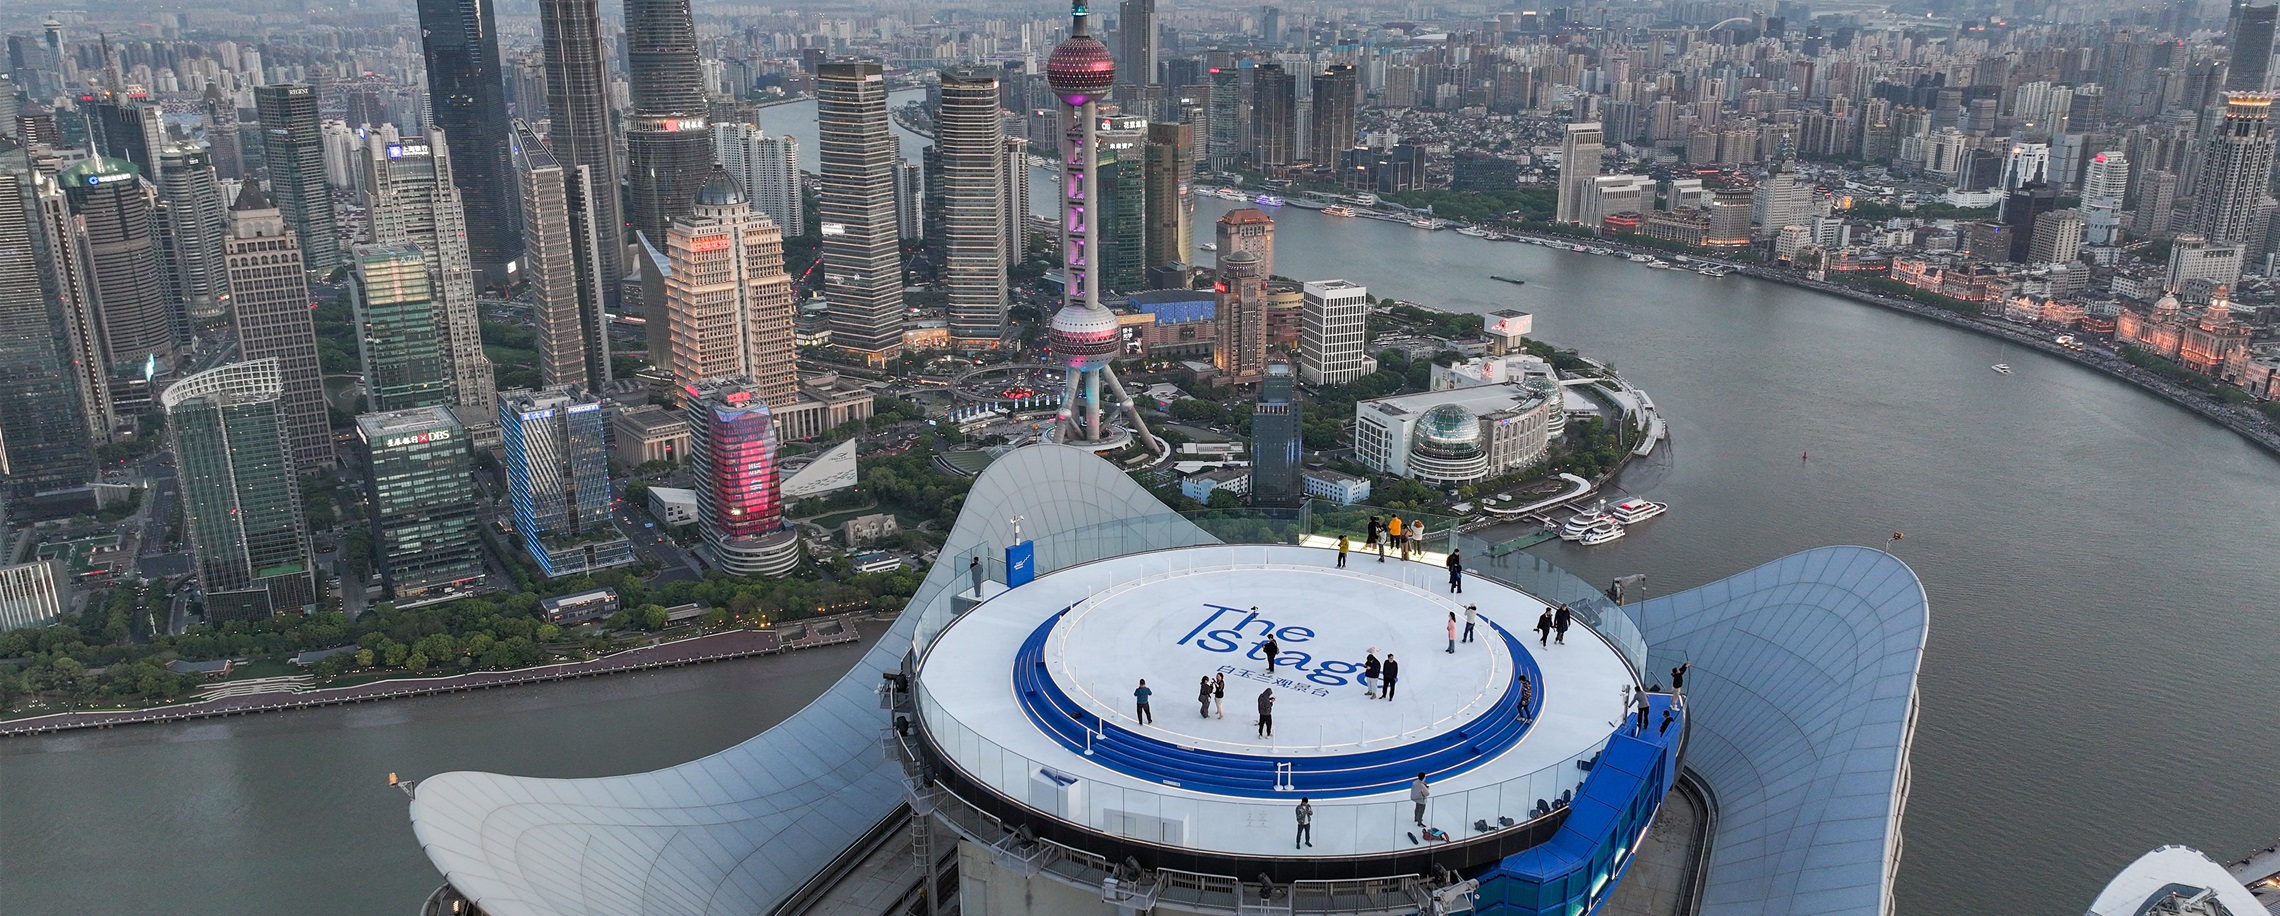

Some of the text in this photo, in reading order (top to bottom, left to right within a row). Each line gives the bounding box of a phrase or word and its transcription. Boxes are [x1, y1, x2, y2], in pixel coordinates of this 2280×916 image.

[387, 436, 418, 447] 星展银行
[428, 430, 450, 441] DBS
[1176, 603, 1315, 646] The
[1216, 664, 1329, 698] 白玉兰观景台
